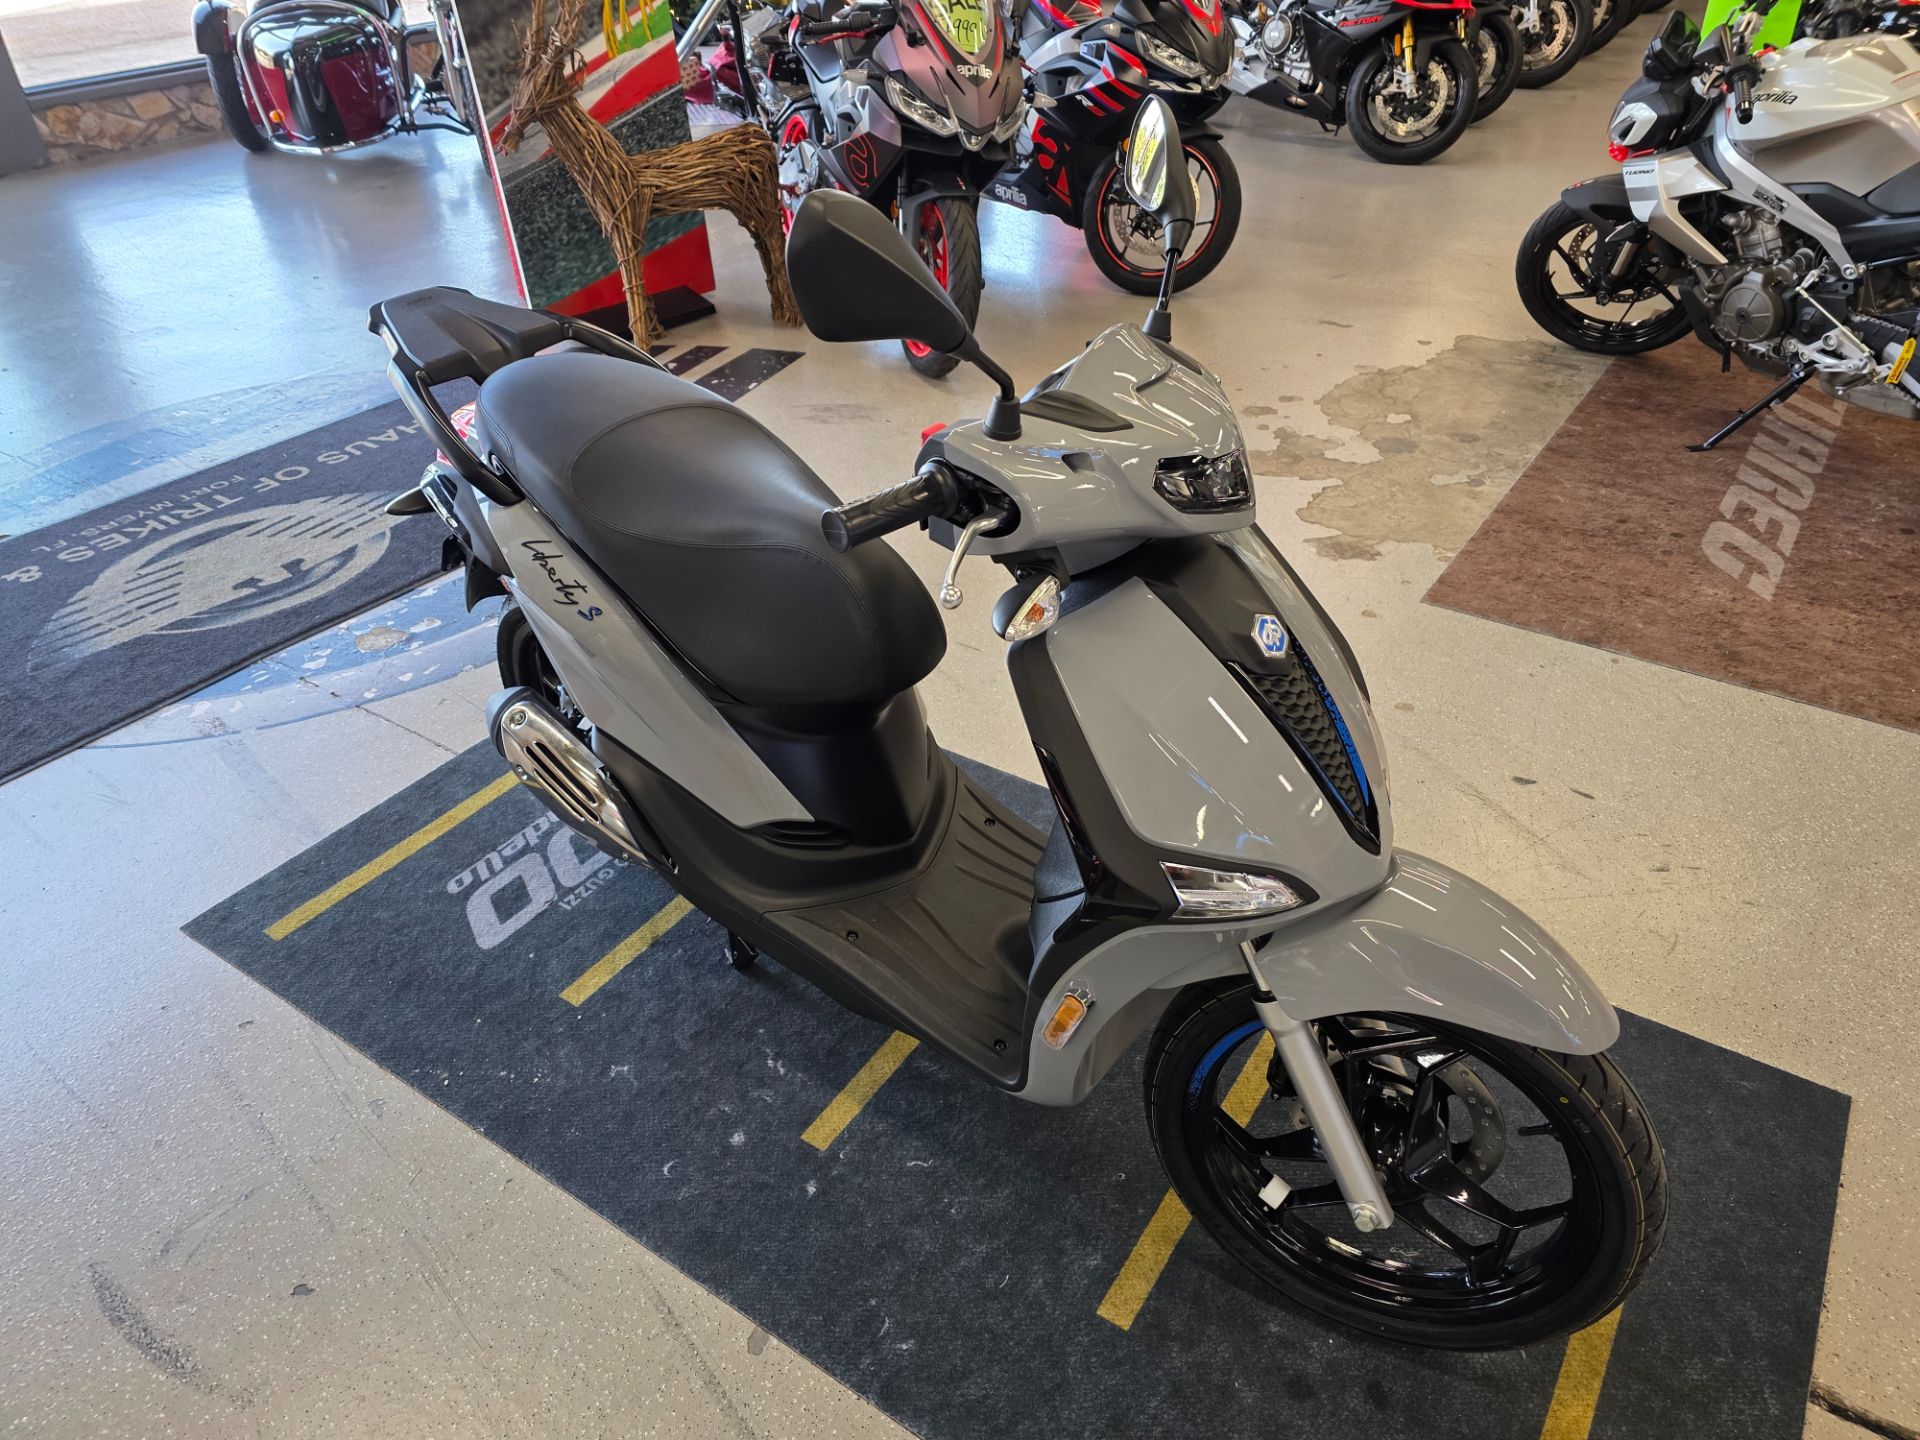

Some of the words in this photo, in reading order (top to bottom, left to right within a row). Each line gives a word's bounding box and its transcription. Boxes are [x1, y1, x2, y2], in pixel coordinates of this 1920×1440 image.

[1337, 14, 1385, 28] FACTORY
[956, 63, 993, 79] aprilia
[994, 182, 1028, 207] aprilia
[316, 418, 422, 465] HAUS
[178, 474, 245, 502] FORT
[252, 466, 310, 493] OF
[57, 494, 244, 562] TRIKES
[31, 539, 68, 552] FL
[521, 540, 588, 606] Liberty
[577, 605, 603, 621] S
[558, 868, 614, 911] GUZZI
